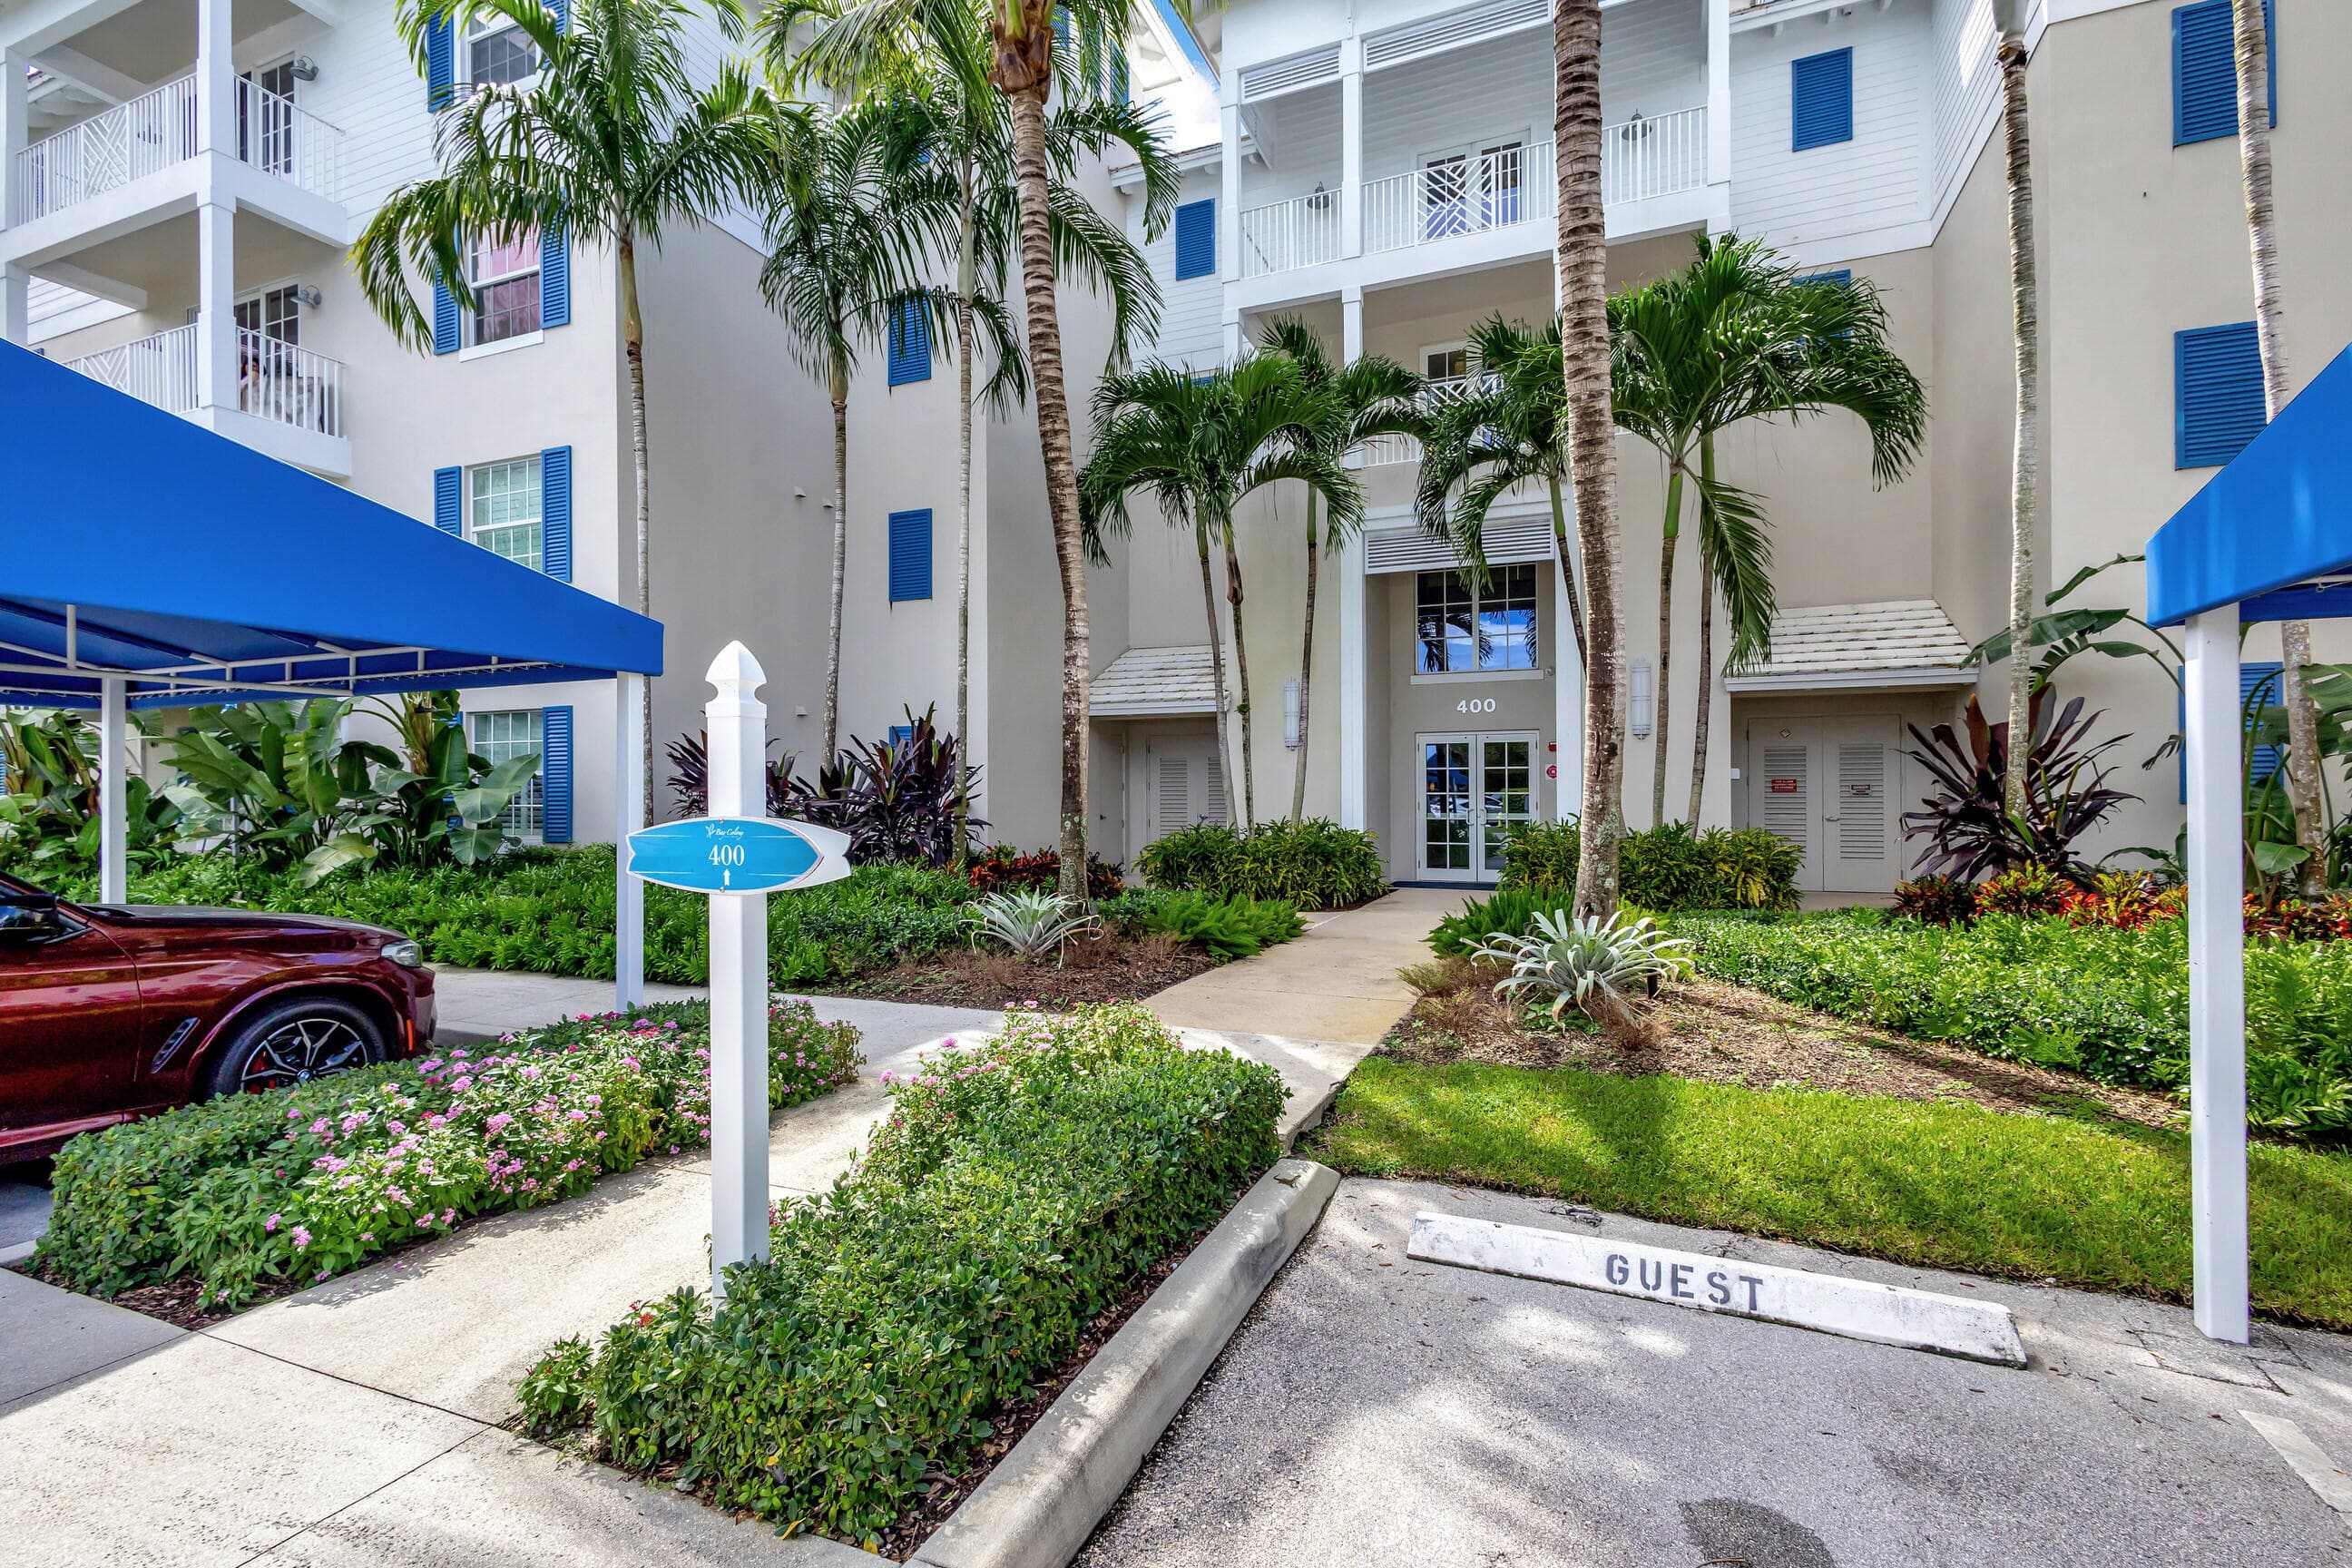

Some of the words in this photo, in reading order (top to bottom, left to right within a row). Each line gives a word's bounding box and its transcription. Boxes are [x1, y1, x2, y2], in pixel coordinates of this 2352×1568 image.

[1456, 698, 1496, 713] 400
[708, 844, 745, 867] 400
[1605, 1253, 1764, 1311] GUEST
